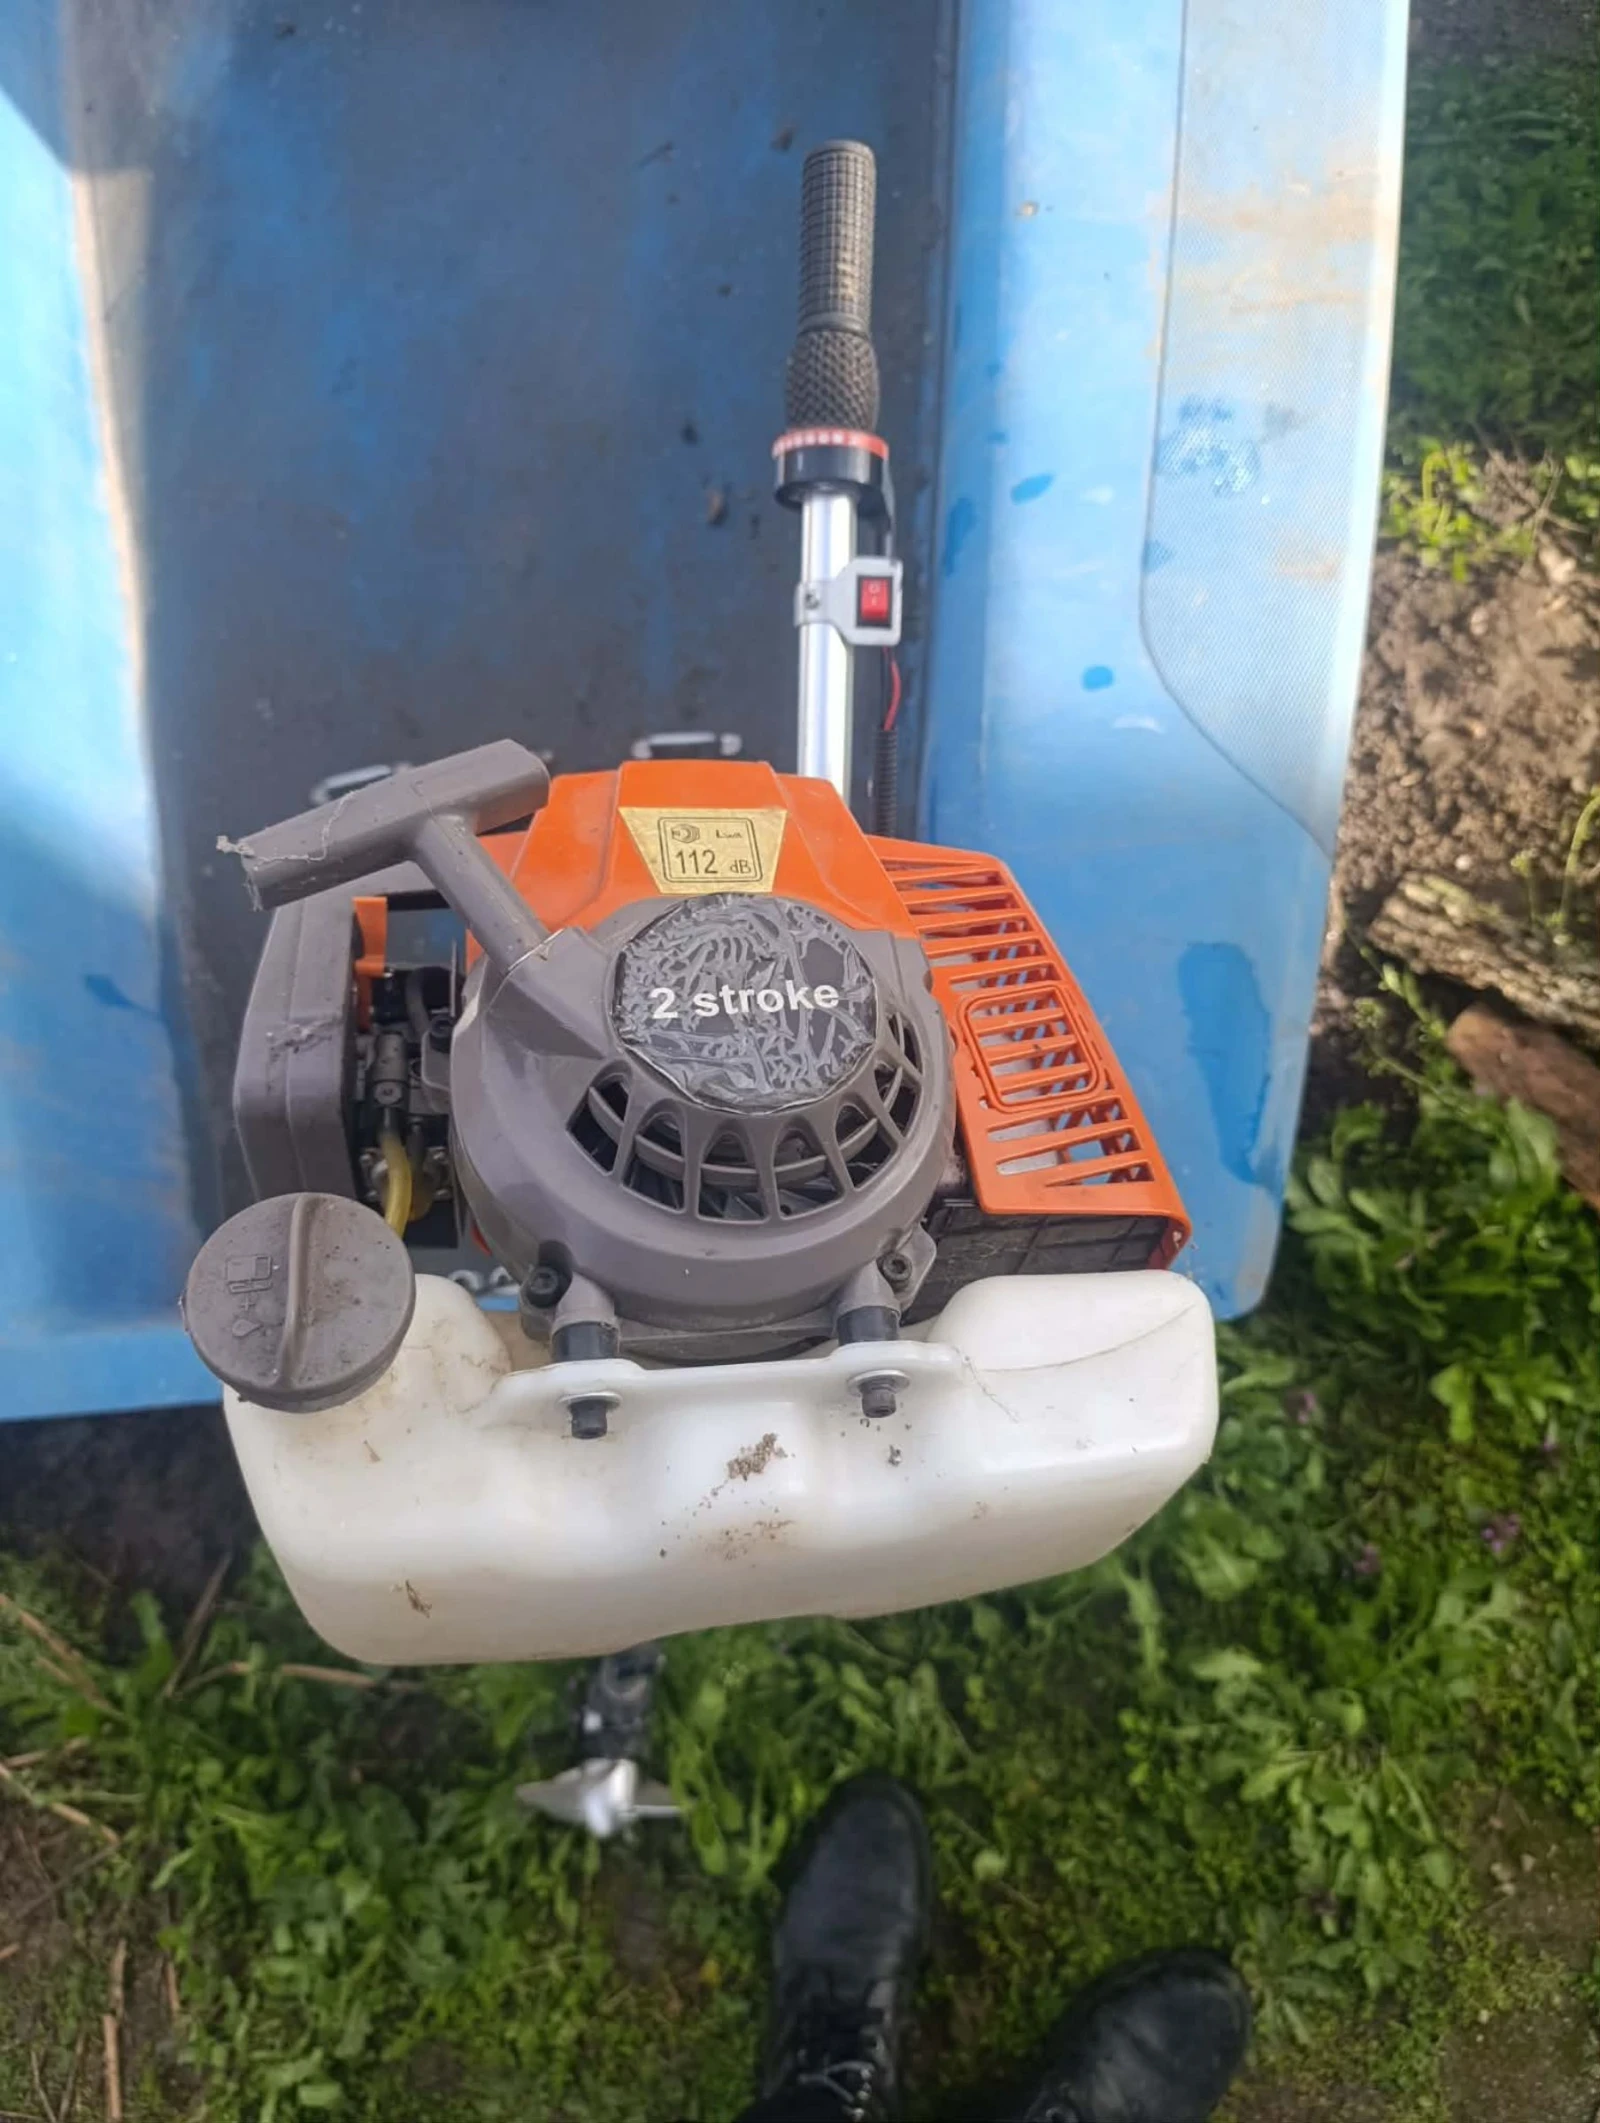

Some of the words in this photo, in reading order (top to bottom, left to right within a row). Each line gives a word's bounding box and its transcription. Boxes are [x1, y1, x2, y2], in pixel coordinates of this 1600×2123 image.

[676, 849, 718, 874] 112
[730, 859, 751, 874] dB
[650, 987, 679, 1019] 2
[693, 980, 840, 1017] stroke
